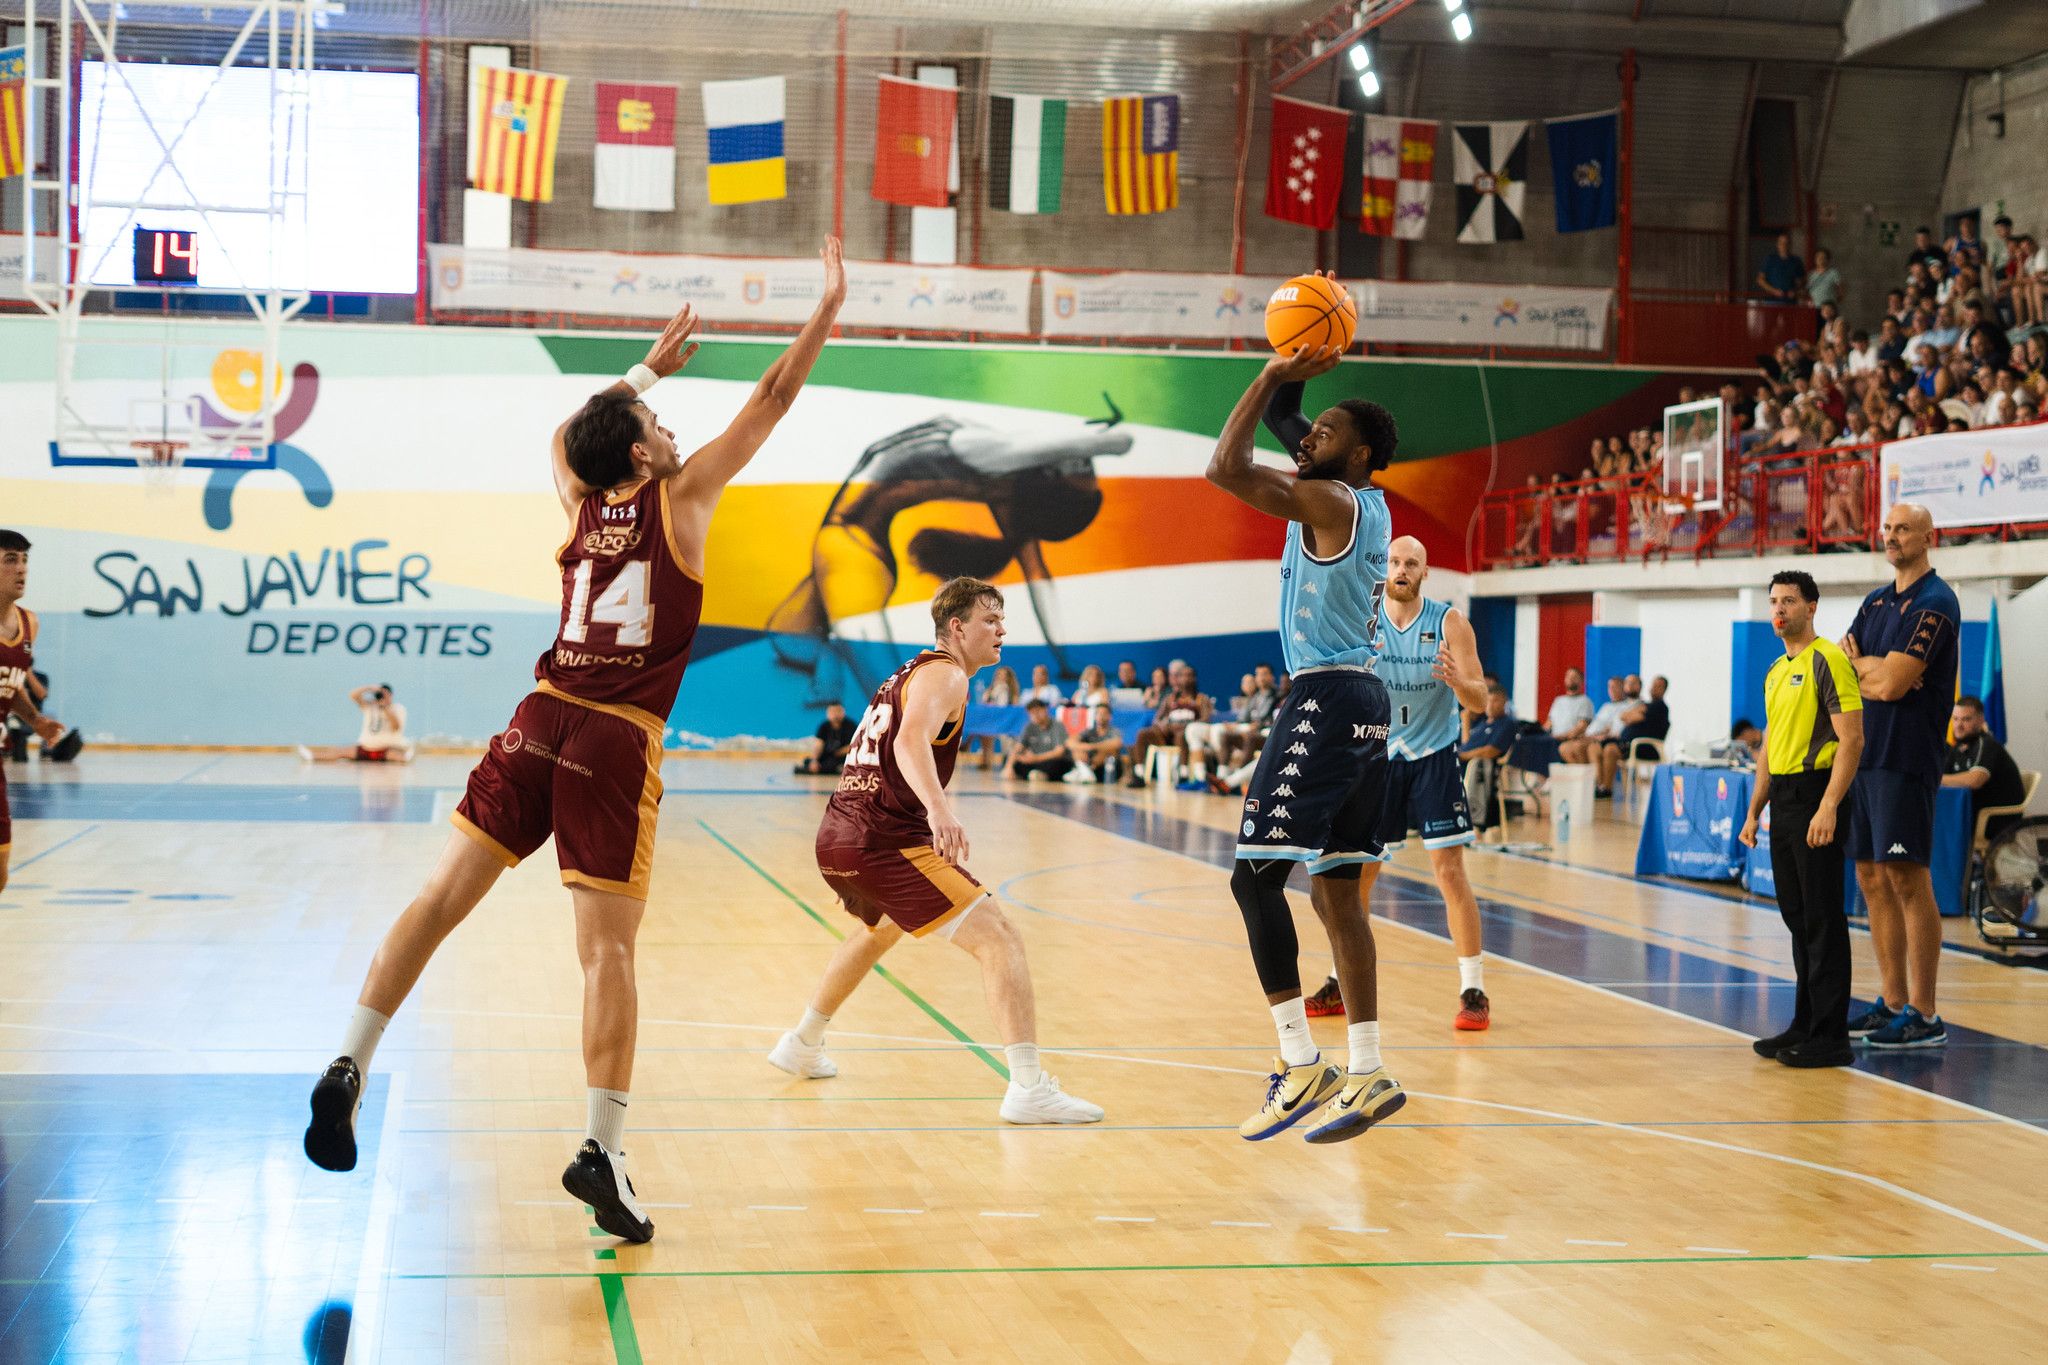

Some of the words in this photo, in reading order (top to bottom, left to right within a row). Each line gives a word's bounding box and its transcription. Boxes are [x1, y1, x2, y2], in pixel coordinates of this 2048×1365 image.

[153, 231, 197, 275] 14
[83, 552, 202, 617] SAN
[220, 539, 432, 616] JAVIER
[562, 559, 656, 648] 14
[247, 622, 493, 656] DEPORTES
[1386, 679, 1437, 692] Andorra
[1399, 704, 1410, 726] 1
[562, 759, 593, 778] MURCIA
